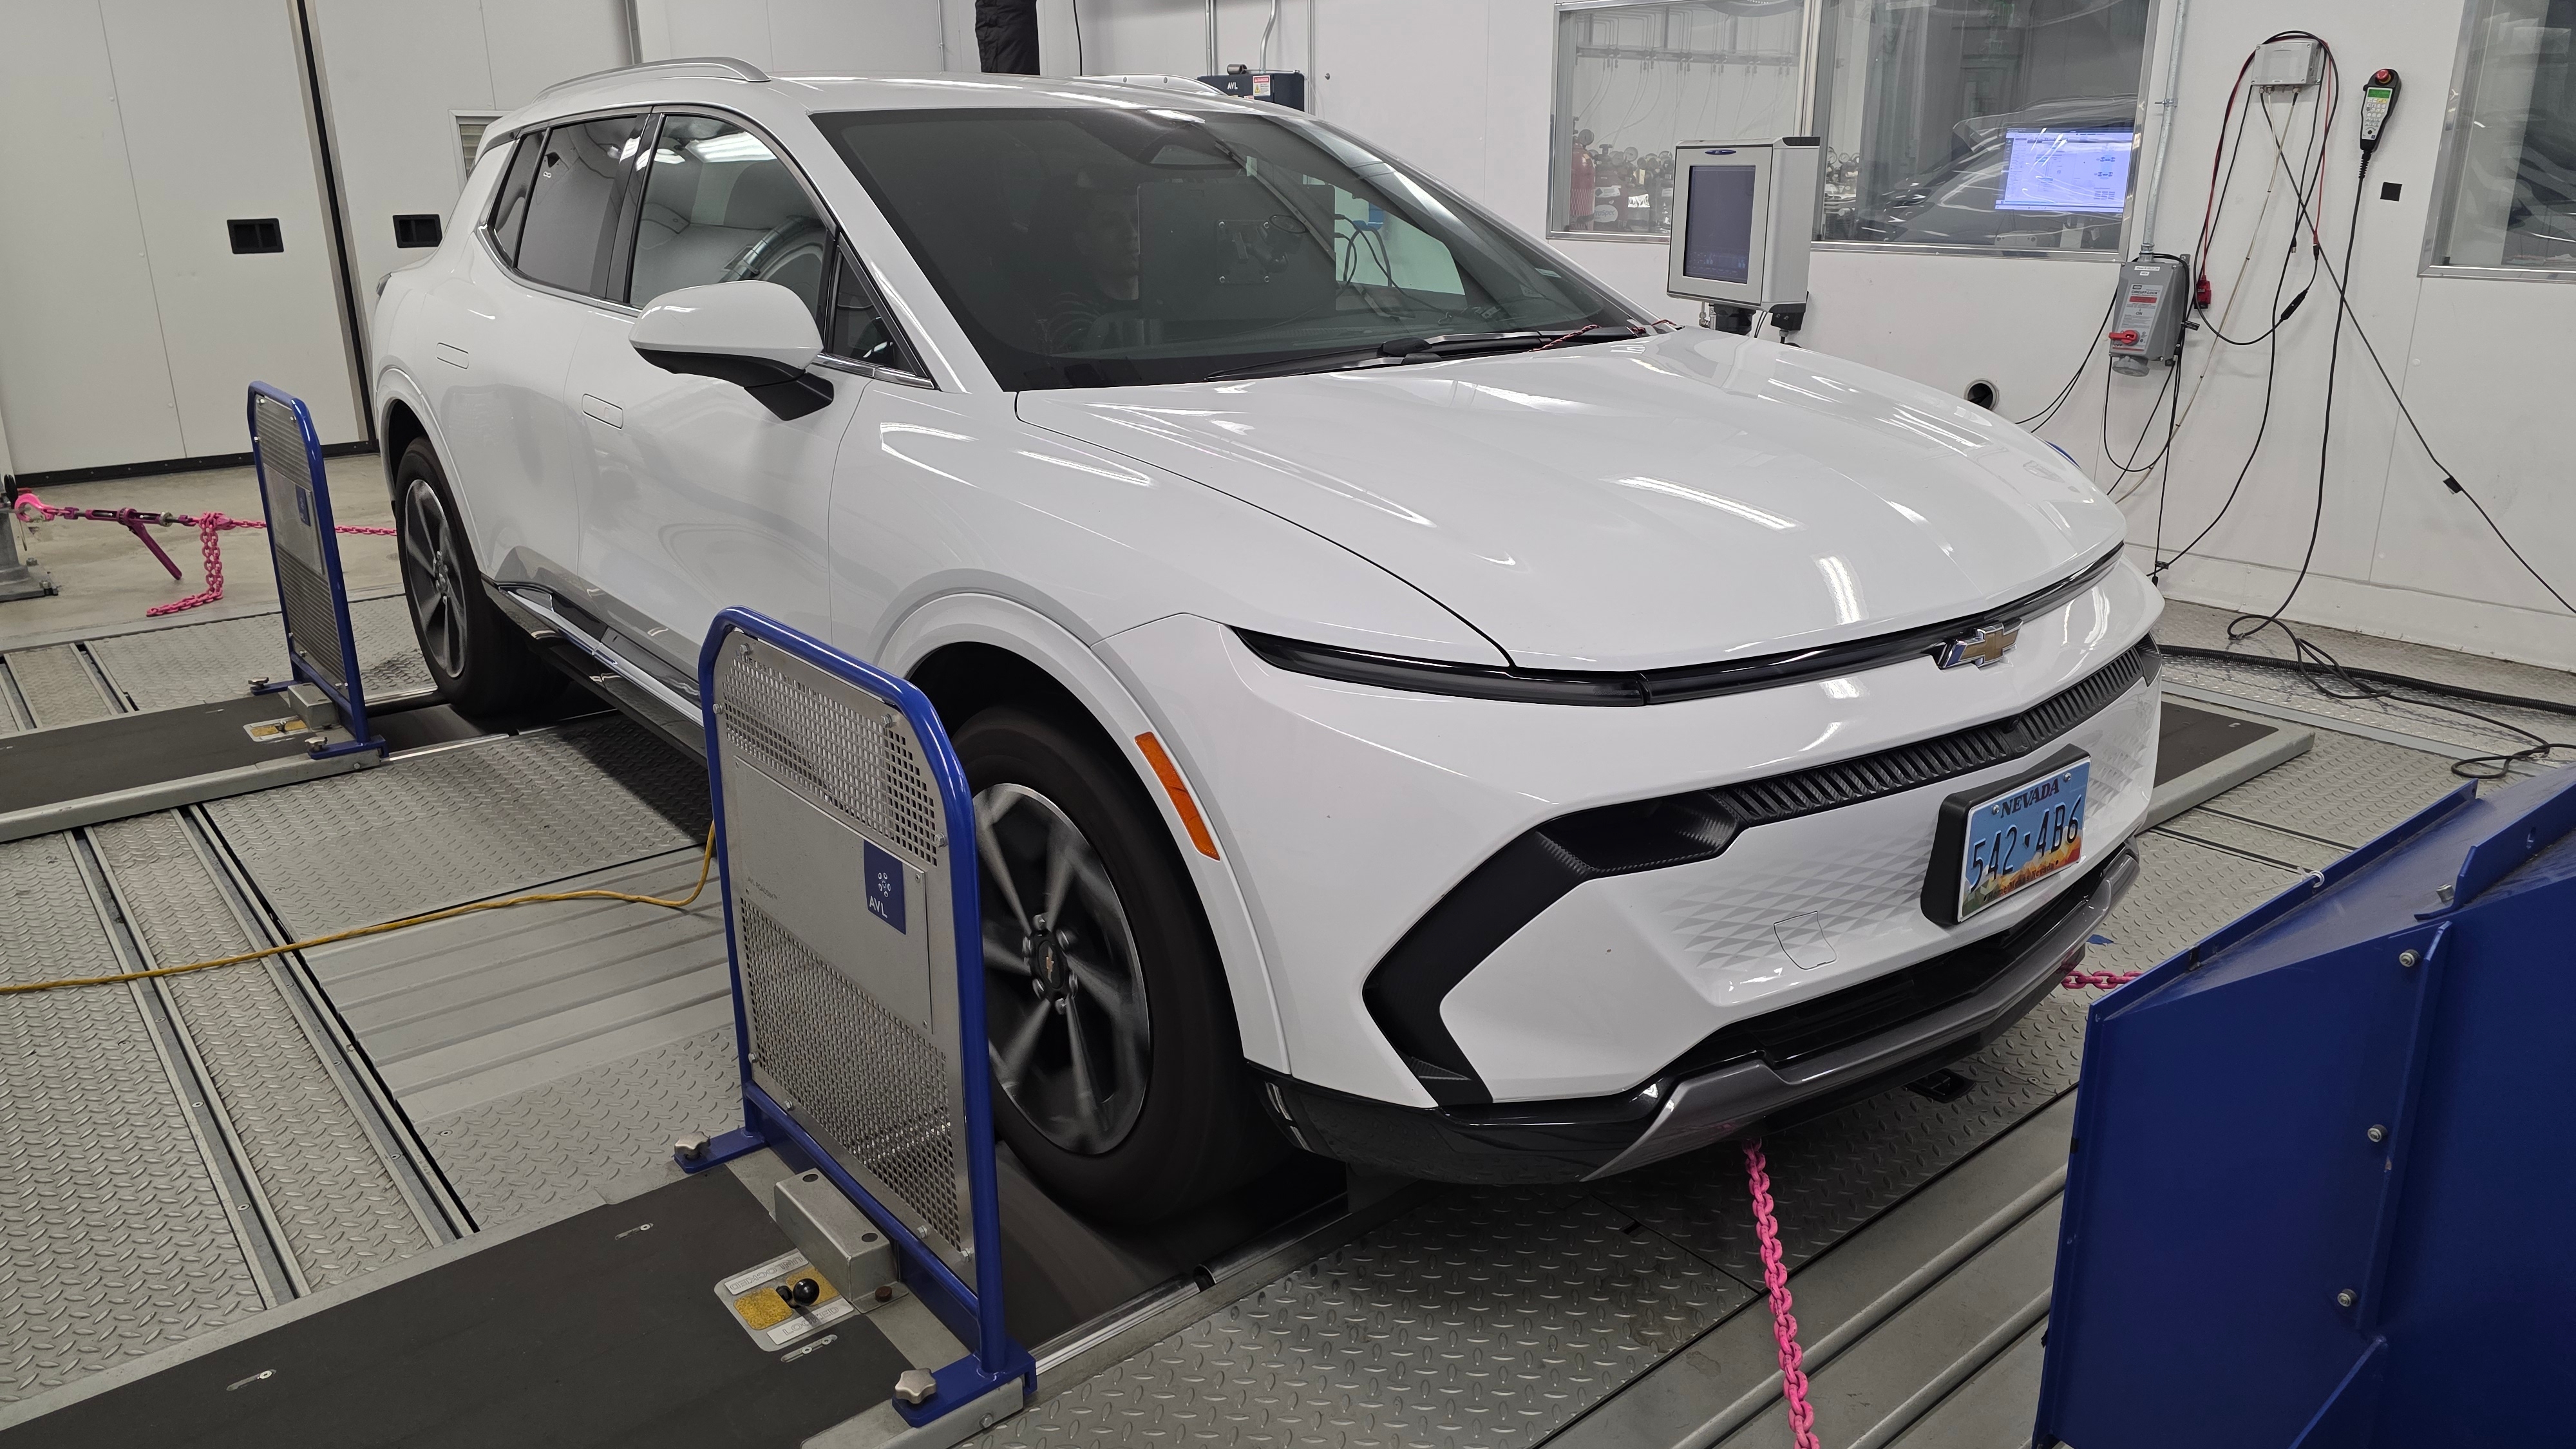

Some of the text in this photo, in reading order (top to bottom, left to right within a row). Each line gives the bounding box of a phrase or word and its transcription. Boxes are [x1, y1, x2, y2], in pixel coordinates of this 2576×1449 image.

[2000, 778, 2060, 819] NEVADA
[1988, 862, 2055, 901] Home Means Nevada
[869, 896, 888, 918] AVL
[729, 1256, 804, 1291] UNLOCKED
[782, 1306, 840, 1336] LOCKED
